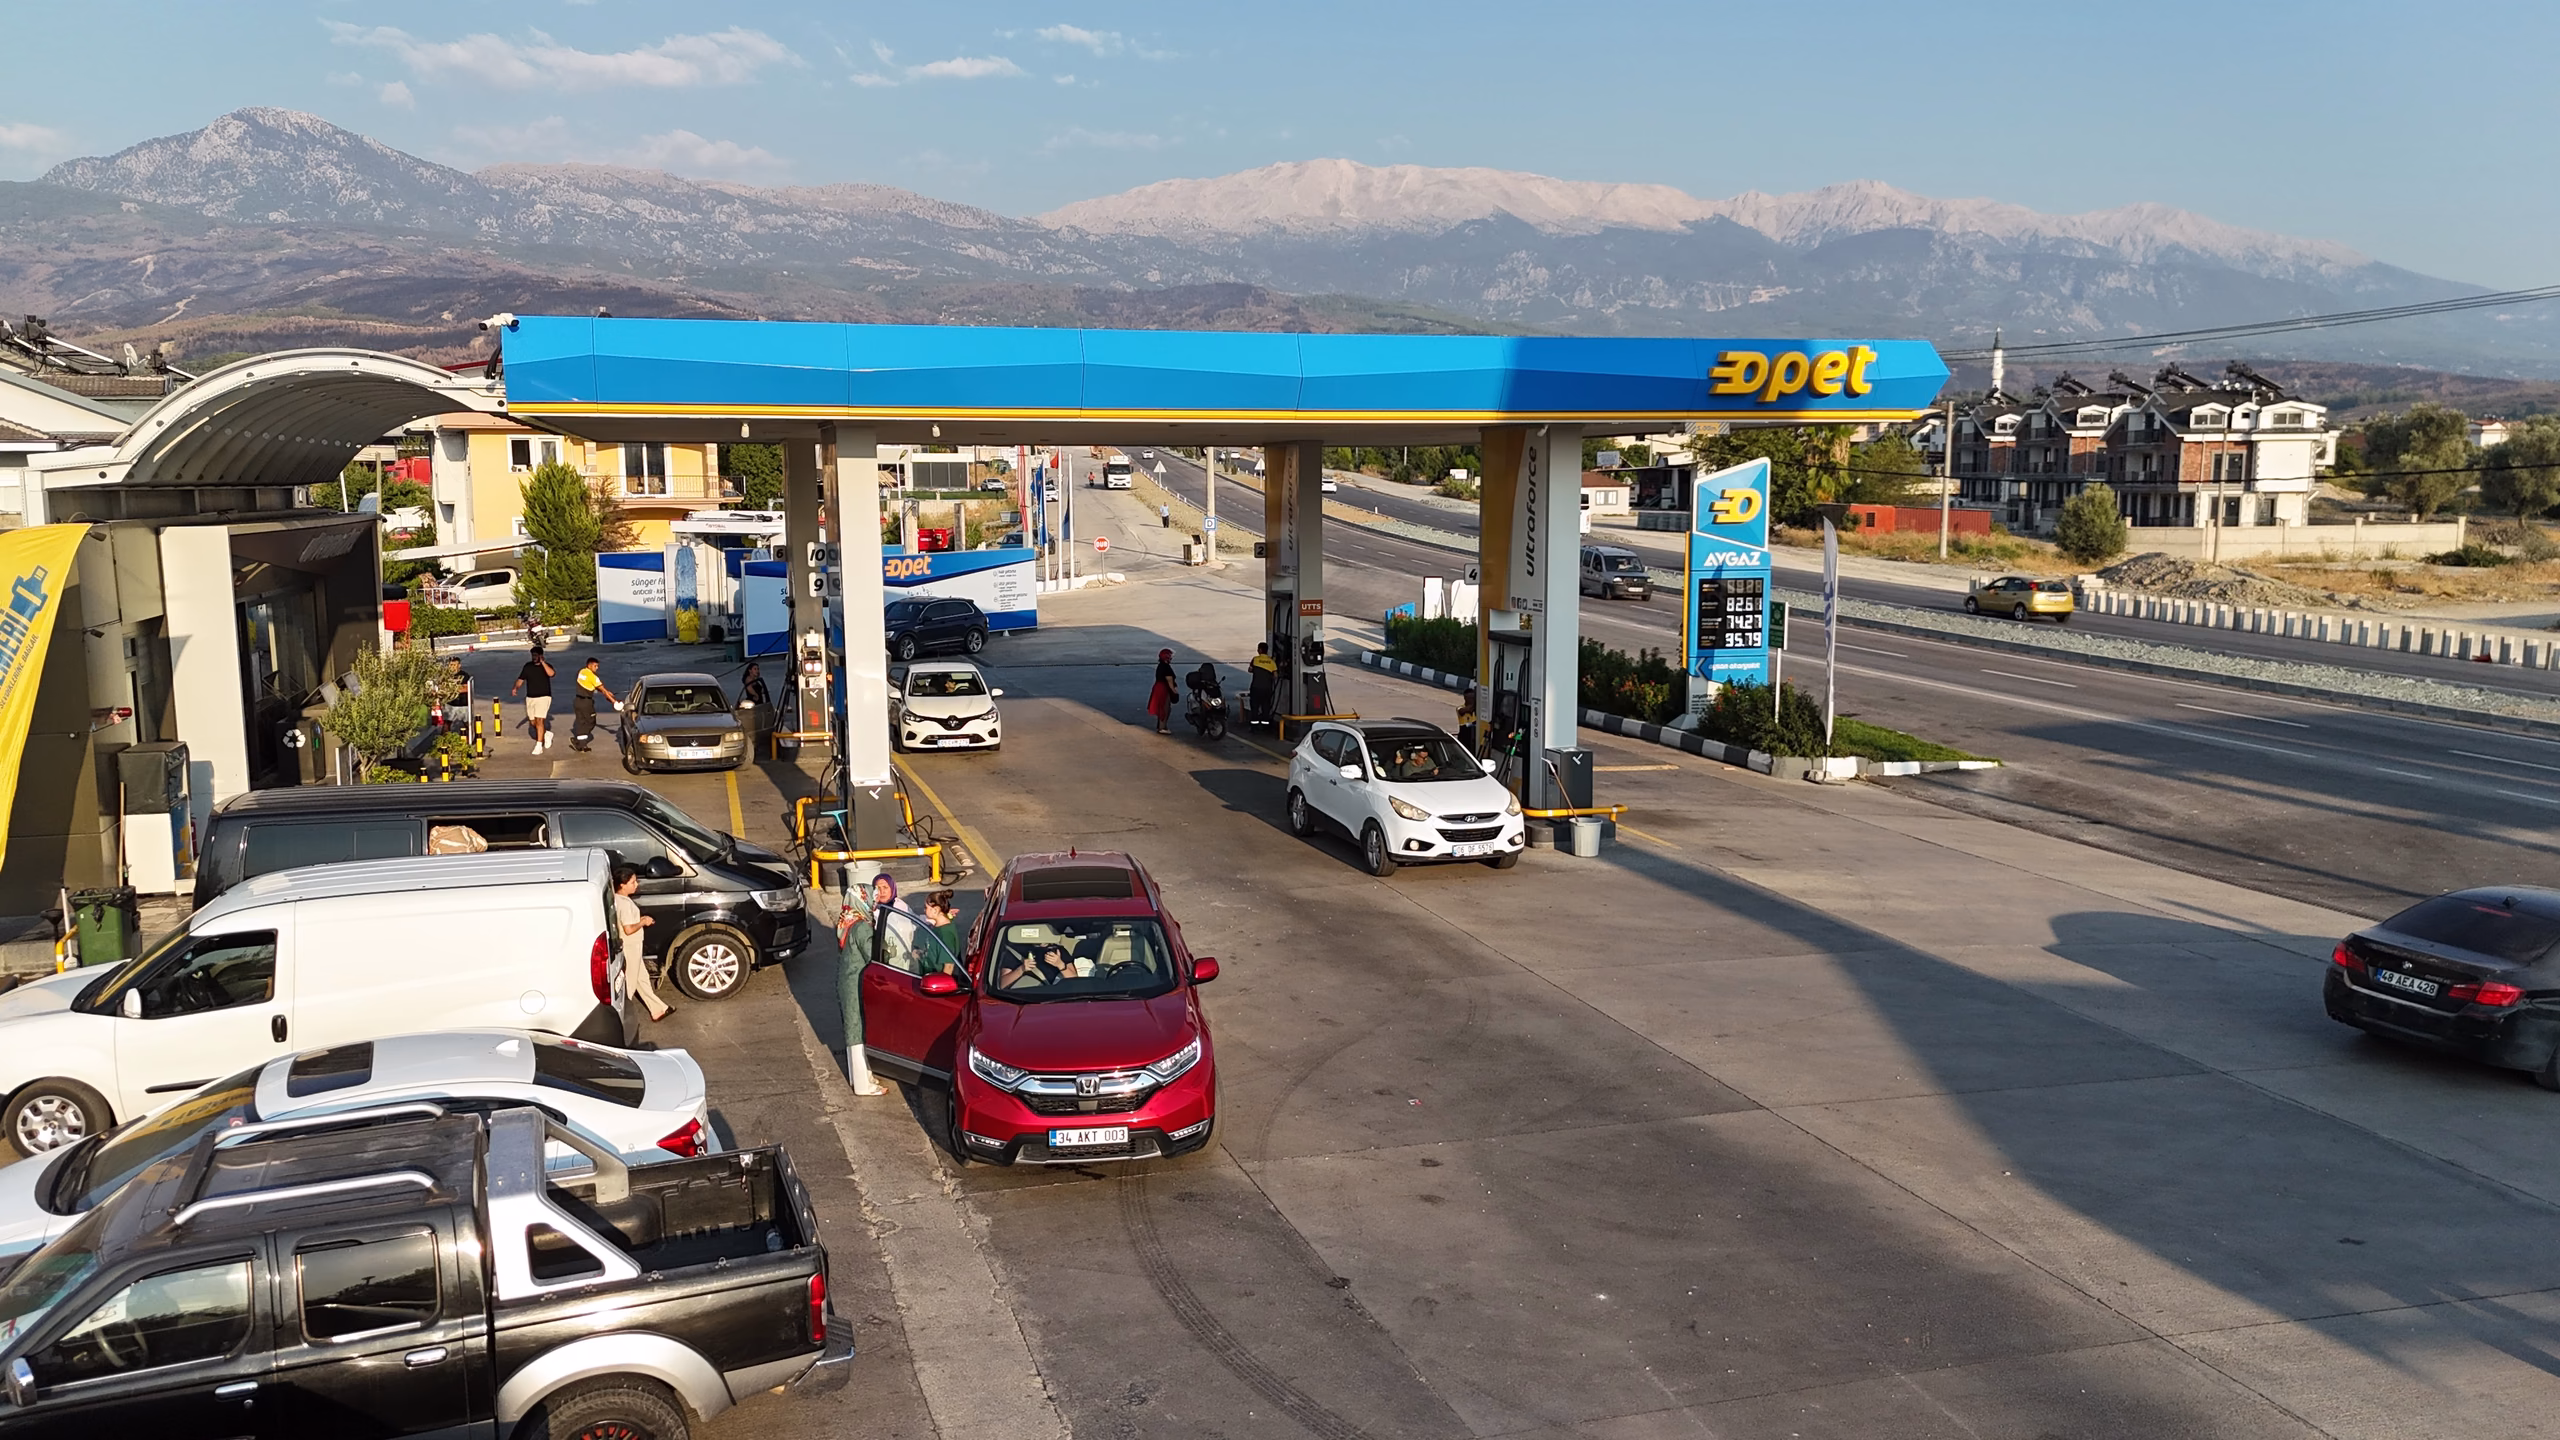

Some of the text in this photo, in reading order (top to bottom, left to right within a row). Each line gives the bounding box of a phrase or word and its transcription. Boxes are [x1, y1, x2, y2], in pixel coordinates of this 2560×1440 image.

[1708, 345, 1877, 403] opet
[1525, 446, 1537, 577] ultraforce
[776, 548, 784, 559] 6
[810, 549, 826, 561] 10
[1256, 546, 1265, 556] 2
[1703, 551, 1761, 567] AYGAZ
[884, 555, 932, 579] opet
[1469, 568, 1478, 580] 4
[814, 578, 824, 592] 9
[2381, 971, 2395, 983] 48
[2395, 975, 2415, 989] AEA
[2416, 981, 2436, 994] 428
[1058, 1129, 1125, 1144] 34 AKT 003
